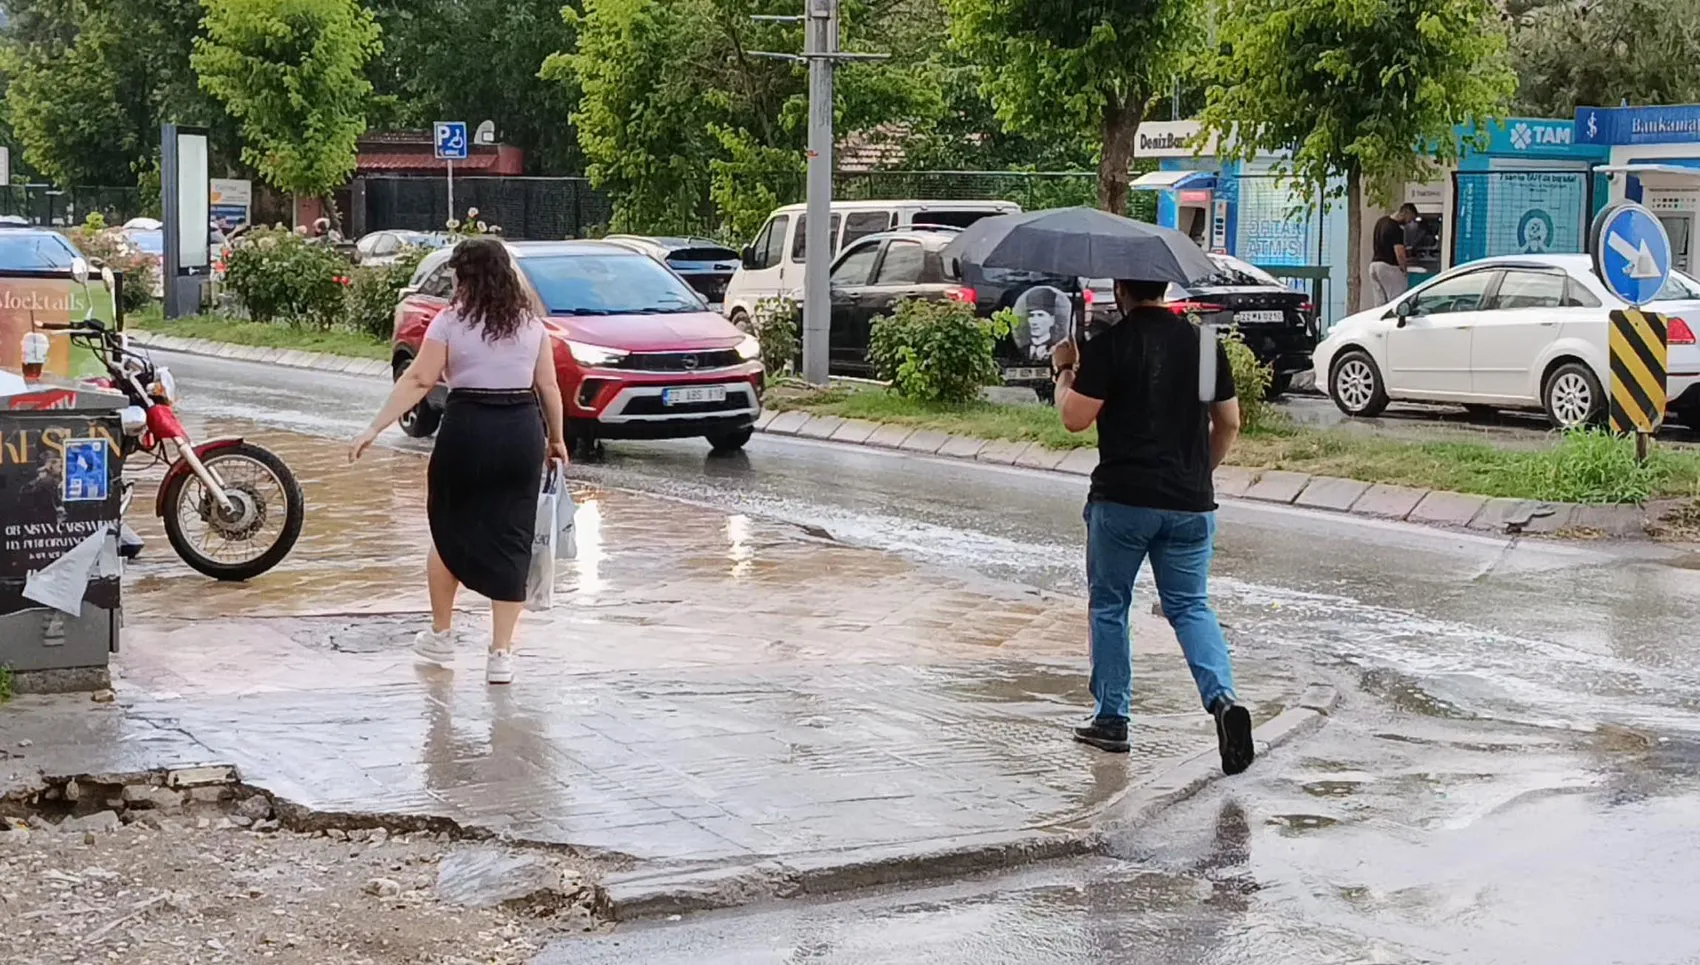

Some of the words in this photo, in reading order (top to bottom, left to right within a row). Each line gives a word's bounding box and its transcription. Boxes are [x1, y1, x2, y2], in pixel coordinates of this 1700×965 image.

[1632, 116, 1700, 135] Bankama
[437, 125, 450, 146] P
[1140, 132, 1190, 150] DenizBan
[1532, 126, 1571, 144] TAM
